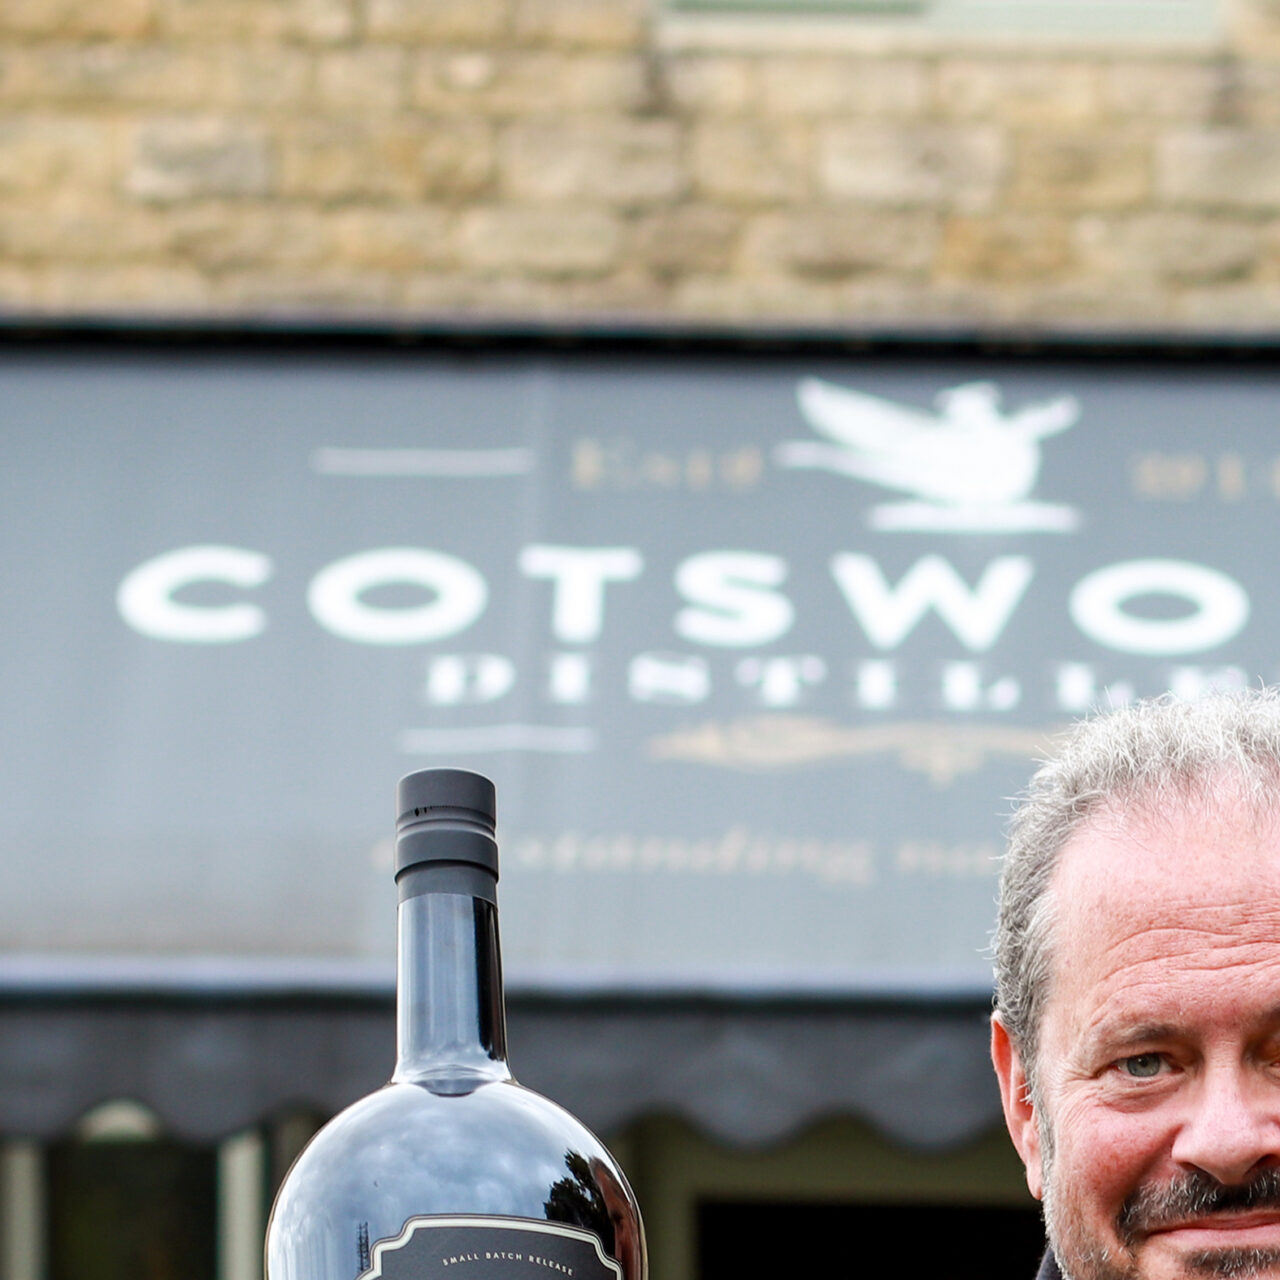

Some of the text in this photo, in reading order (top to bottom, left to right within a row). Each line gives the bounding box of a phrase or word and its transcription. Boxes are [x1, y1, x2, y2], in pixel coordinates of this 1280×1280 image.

[442, 1251, 573, 1276] SMALL BATCH RELEASE
